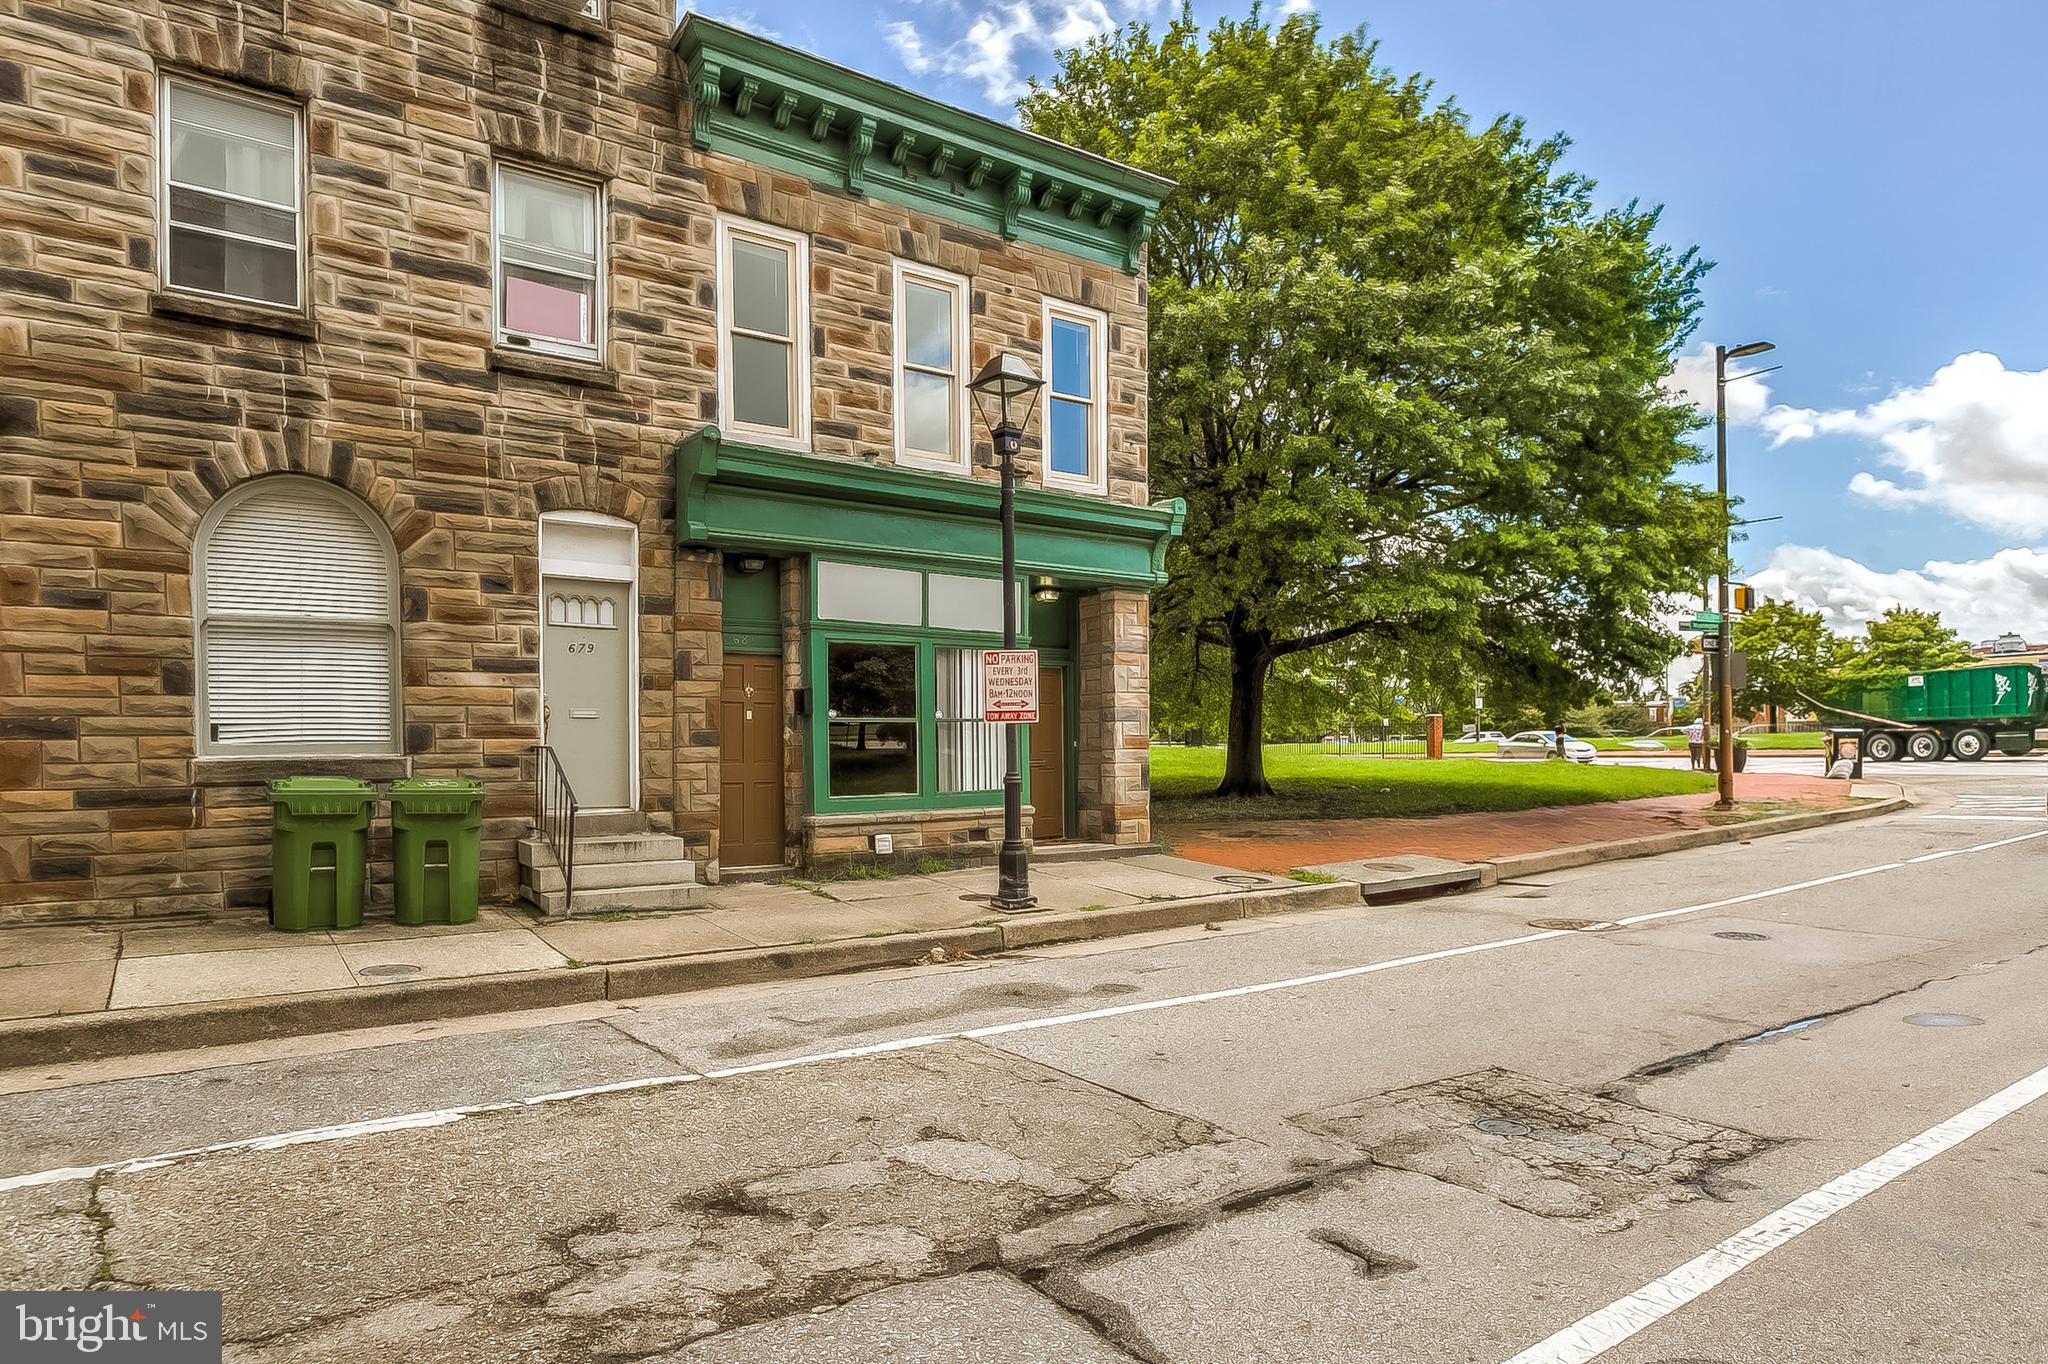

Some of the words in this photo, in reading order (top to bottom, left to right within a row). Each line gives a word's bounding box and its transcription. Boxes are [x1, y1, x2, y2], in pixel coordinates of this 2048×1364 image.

[568, 643, 595, 654] 679
[985, 653, 999, 664] NO
[1001, 654, 1034, 664] PARKING
[992, 667, 1013, 675] EVERY
[1017, 666, 1028, 675] 3rd
[988, 677, 1033, 686] WEDNESDAY
[987, 712, 999, 720] TOW
[1000, 712, 1018, 720] AWAY
[1019, 712, 1036, 720] ZONE
